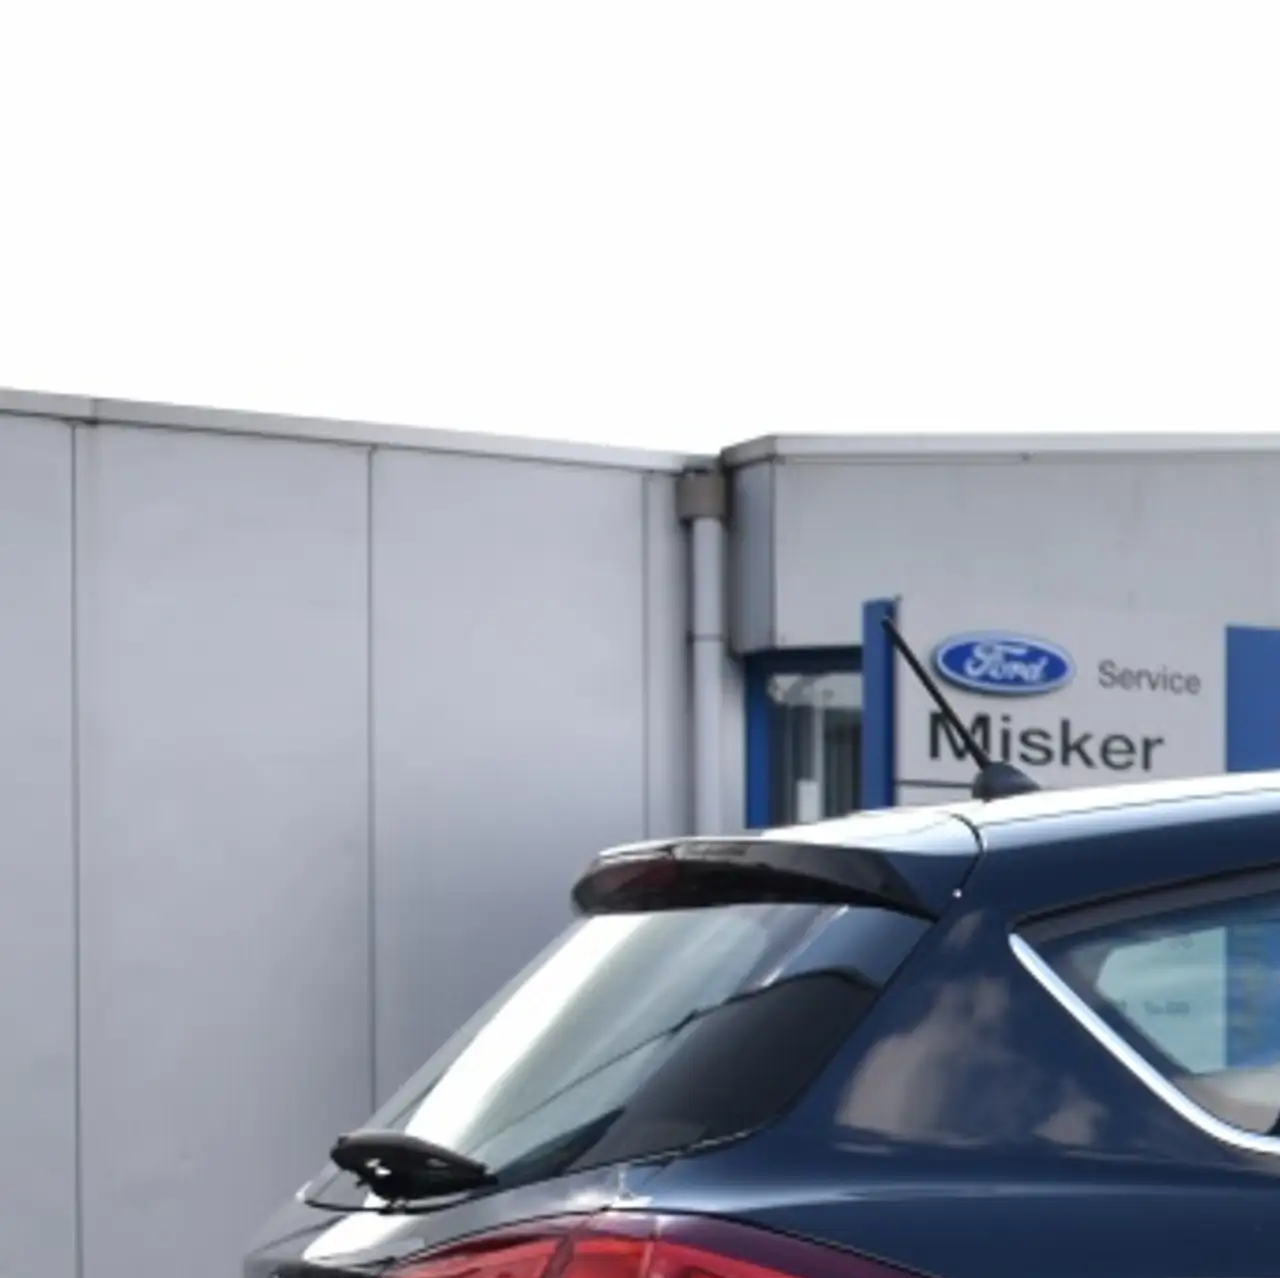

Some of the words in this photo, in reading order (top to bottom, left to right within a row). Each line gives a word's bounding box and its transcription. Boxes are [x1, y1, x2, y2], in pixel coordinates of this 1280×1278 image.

[963, 642, 1049, 681] Ford
[1097, 658, 1202, 696] Service
[929, 711, 1165, 772] Misker
